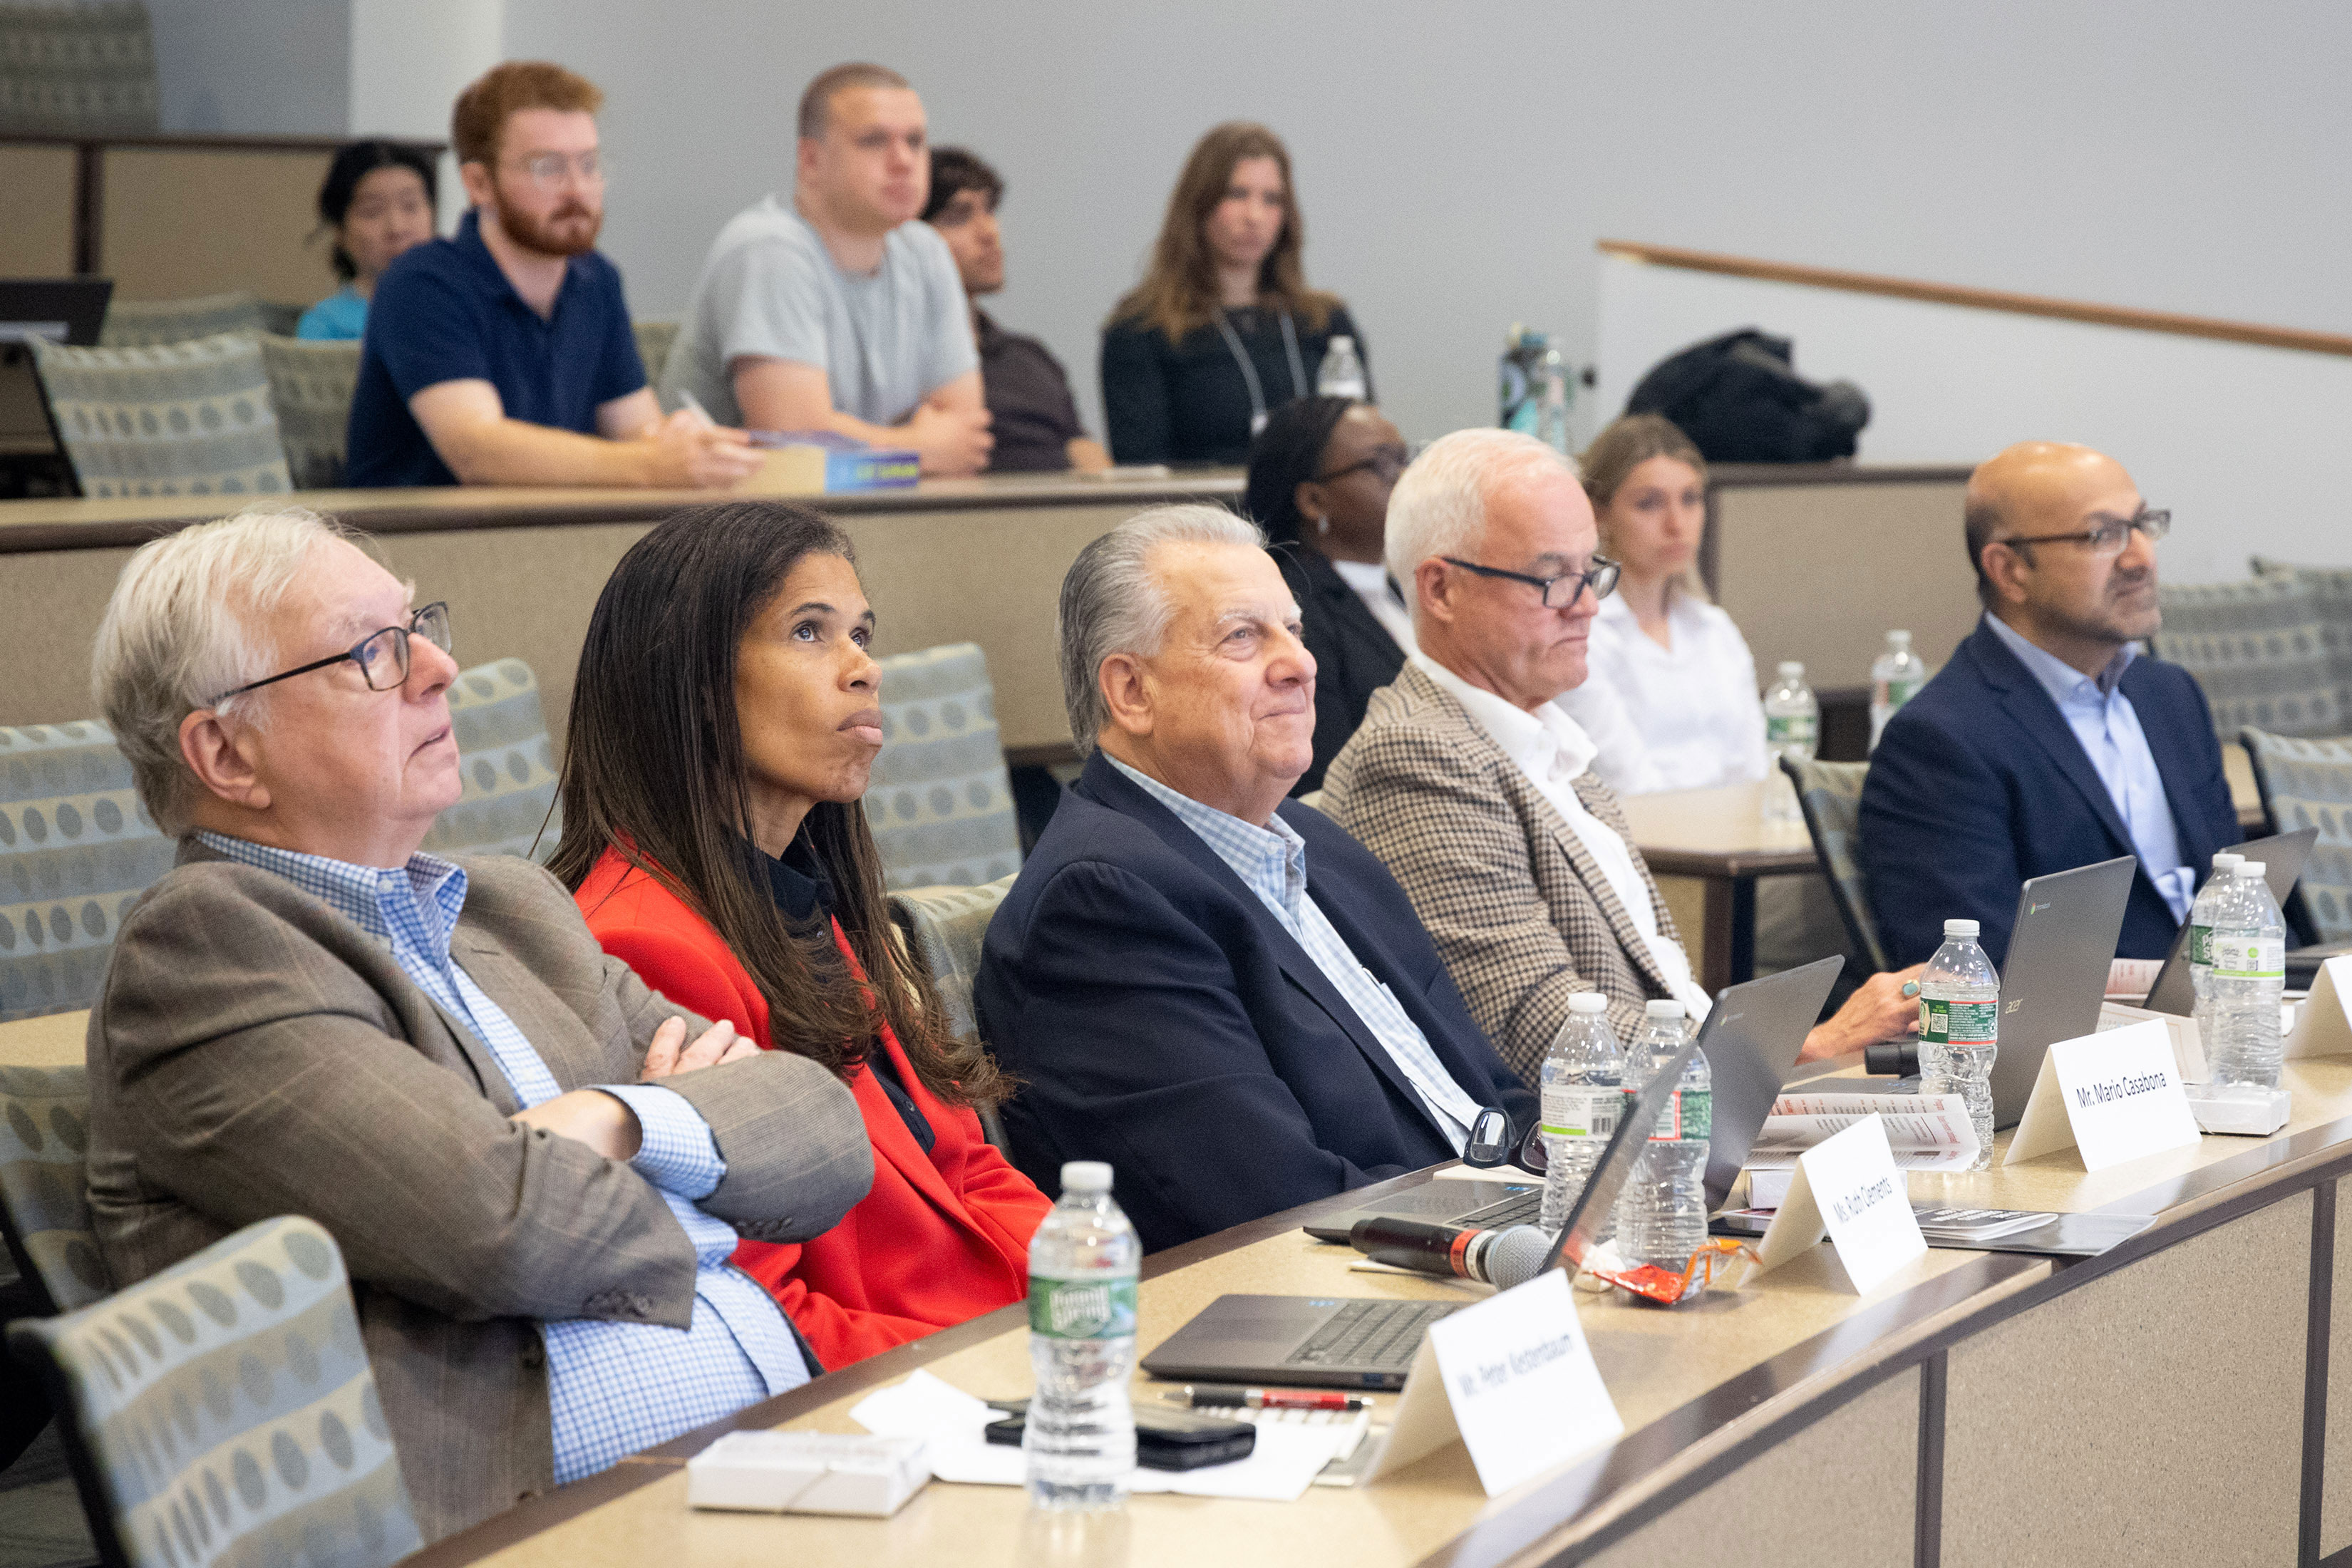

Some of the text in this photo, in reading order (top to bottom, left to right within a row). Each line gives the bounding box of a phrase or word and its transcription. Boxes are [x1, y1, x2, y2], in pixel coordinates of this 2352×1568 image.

[2005, 999, 2023, 1014] acer
[2076, 1071, 2167, 1108] Mr. Mario Casabona
[1833, 1175, 1892, 1224] Ms. Ruth Clements
